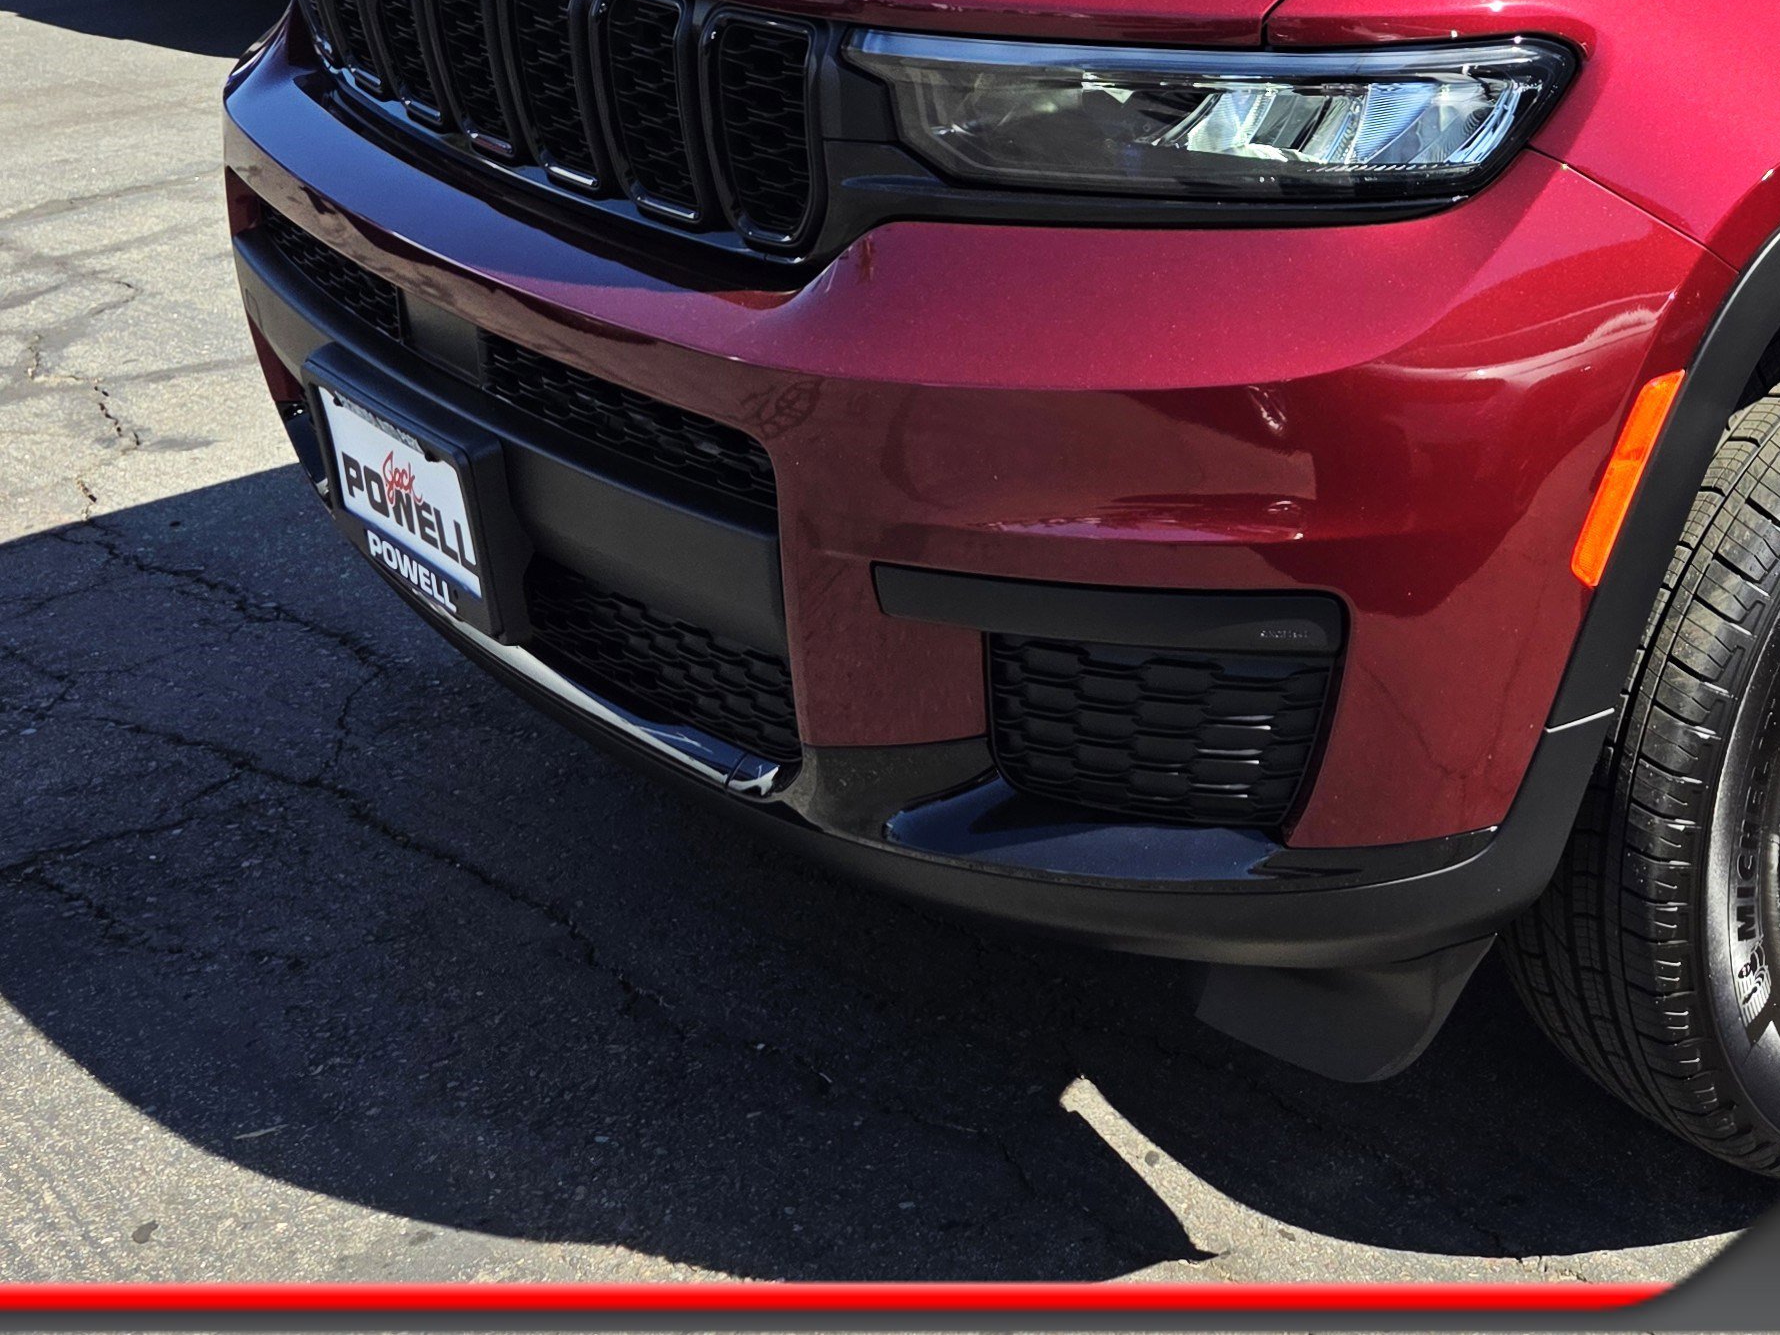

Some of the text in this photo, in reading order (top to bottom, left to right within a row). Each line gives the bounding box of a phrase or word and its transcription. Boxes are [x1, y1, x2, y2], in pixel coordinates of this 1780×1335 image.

[341, 452, 477, 566] POWELL
[381, 450, 424, 508] Jack
[366, 529, 458, 614] POWELL
